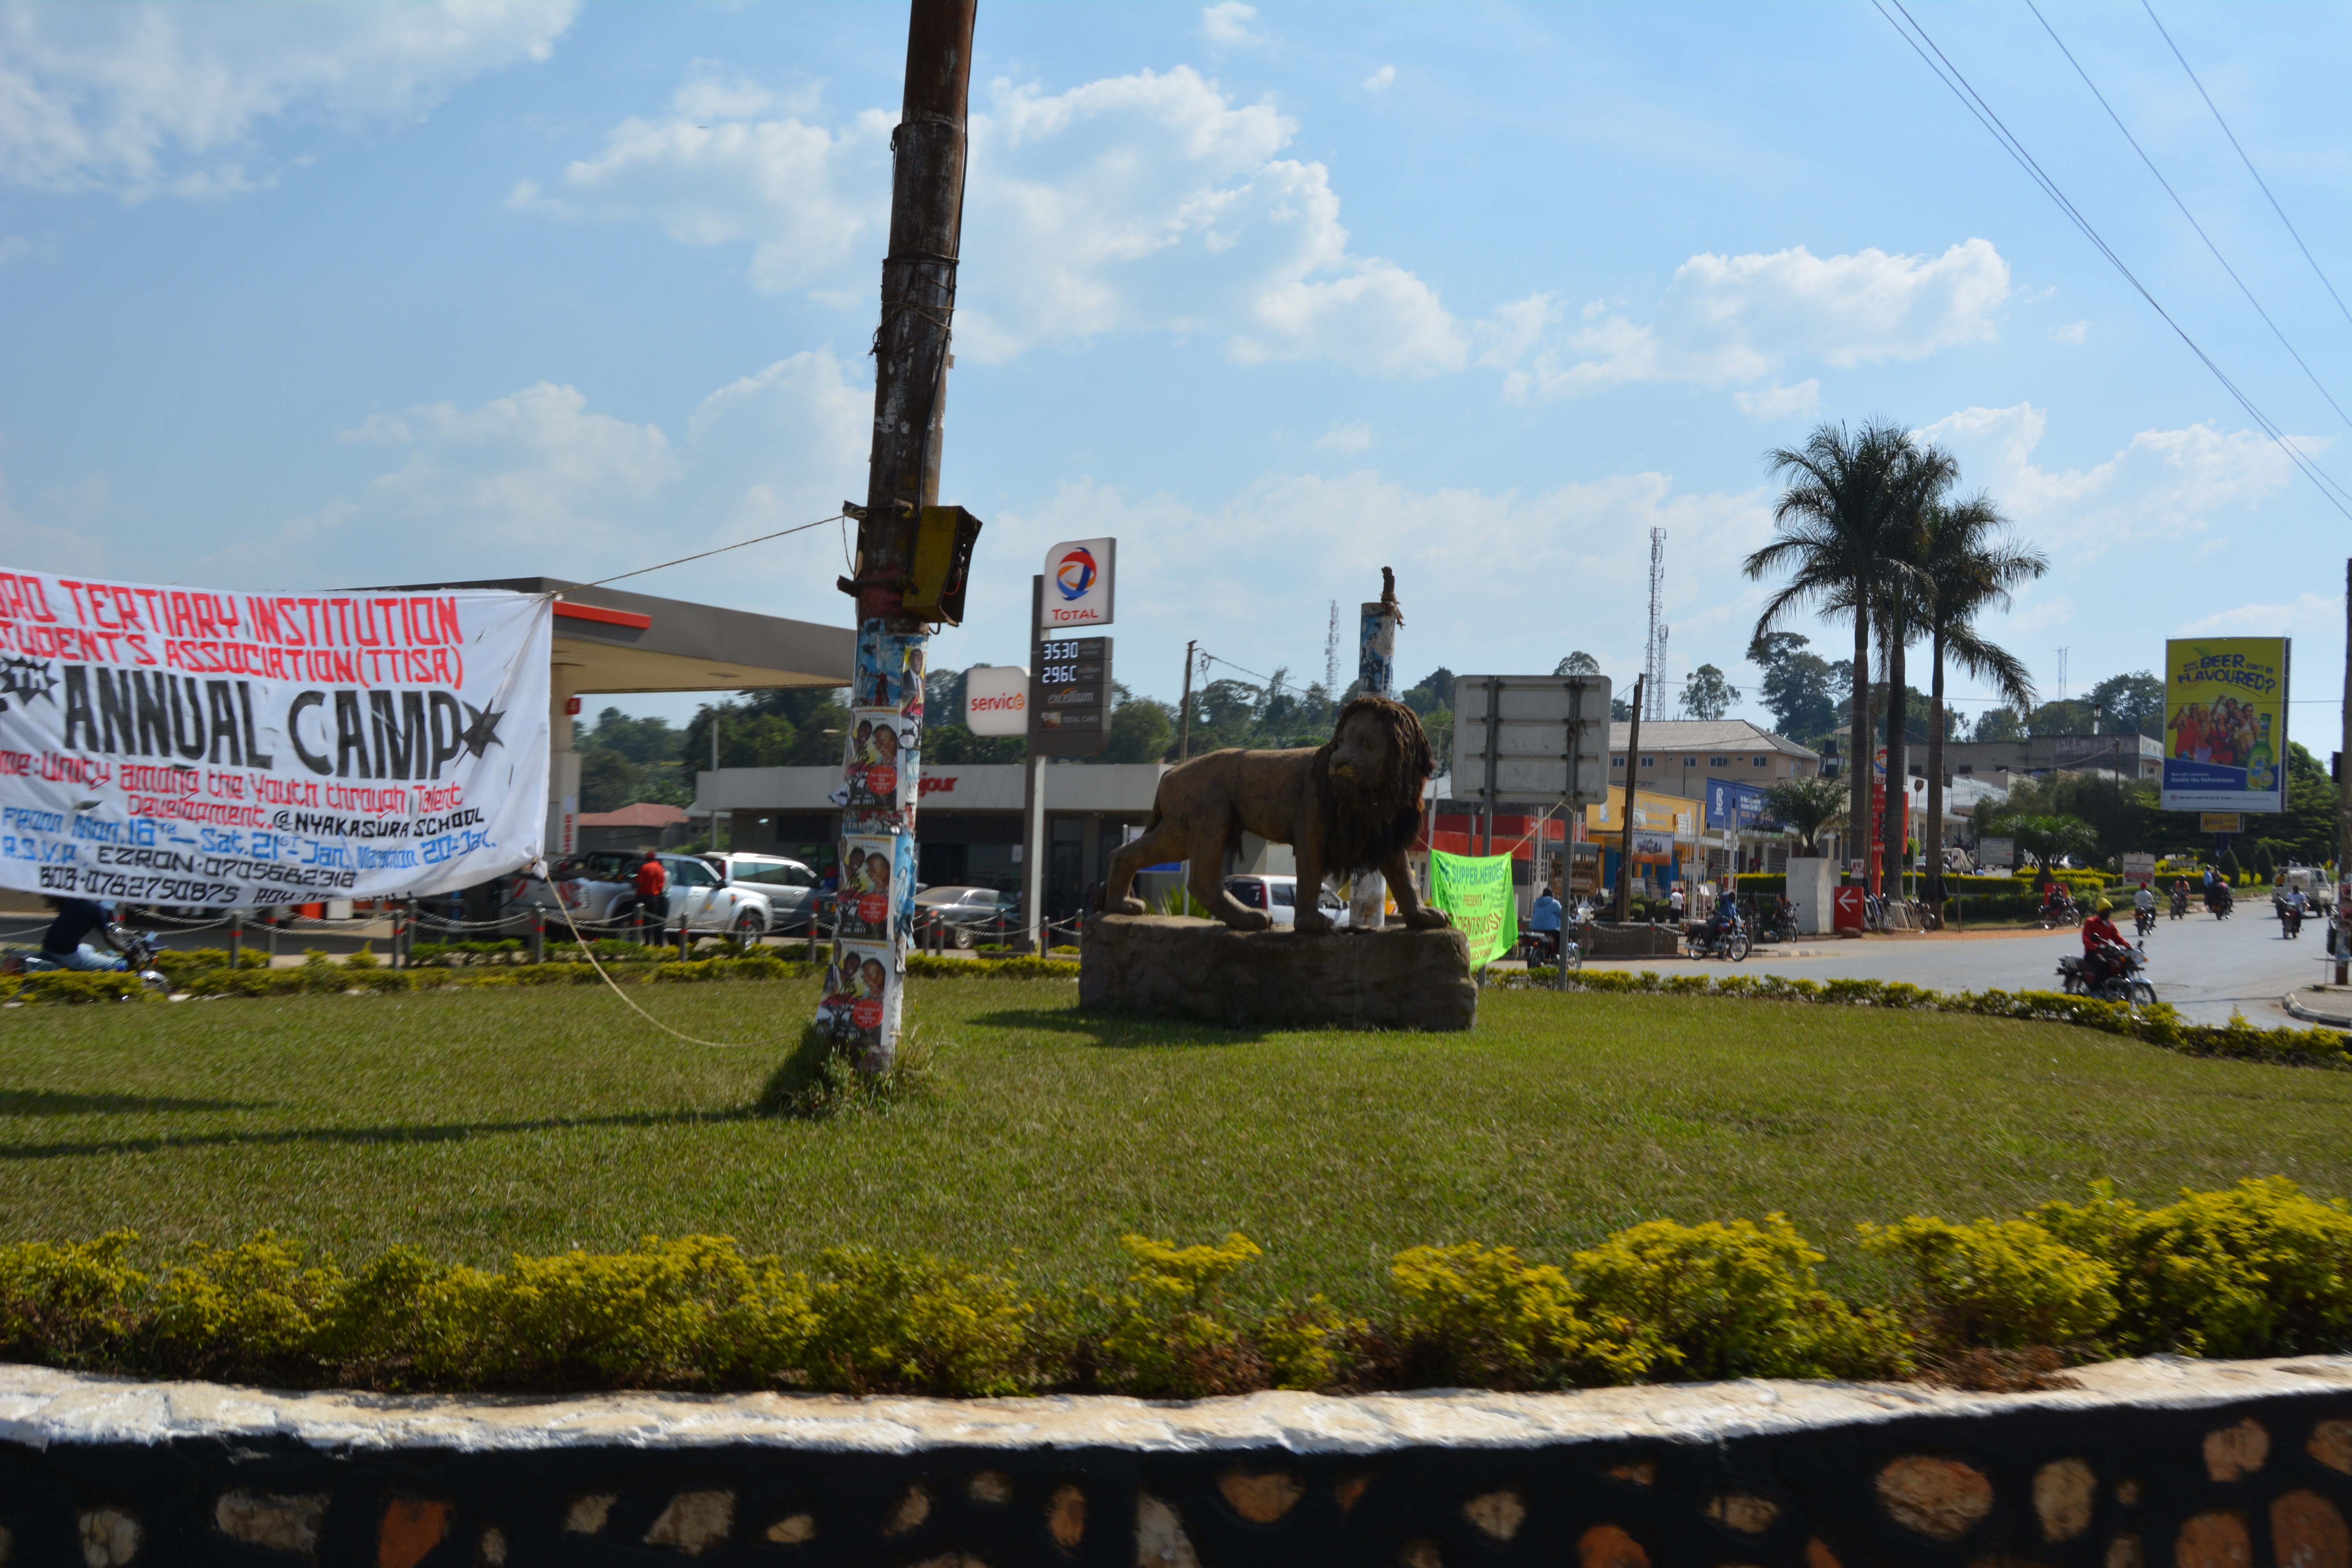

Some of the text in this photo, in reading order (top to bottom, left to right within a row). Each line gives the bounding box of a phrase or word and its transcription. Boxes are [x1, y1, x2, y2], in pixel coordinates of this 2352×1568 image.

[58, 579, 240, 638] TERTIARY
[247, 596, 463, 647] INSTITUTION
[1051, 608, 1099, 621] TOTAL
[0, 620, 158, 665] TUDENT'S
[1044, 642, 1078, 660] 3530
[2200, 653, 2245, 669] BEER
[2177, 669, 2276, 695] FLAVOURED?
[971, 693, 1025, 711] service
[1047, 690, 1094, 705] excellium
[63, 665, 463, 780] ANNUAL CAMP
[120, 764, 200, 801] among
[208, 768, 244, 800] the
[249, 773, 319, 808] Youth
[326, 780, 407, 820] through
[411, 781, 463, 813] Talent
[274, 809, 412, 838] @NYAKASURA
[413, 807, 485, 837] SCHOOL
[1452, 864, 1478, 886] SUPPER
[1479, 861, 1505, 885] HEROES
[1463, 894, 1482, 906] PRESENTS
